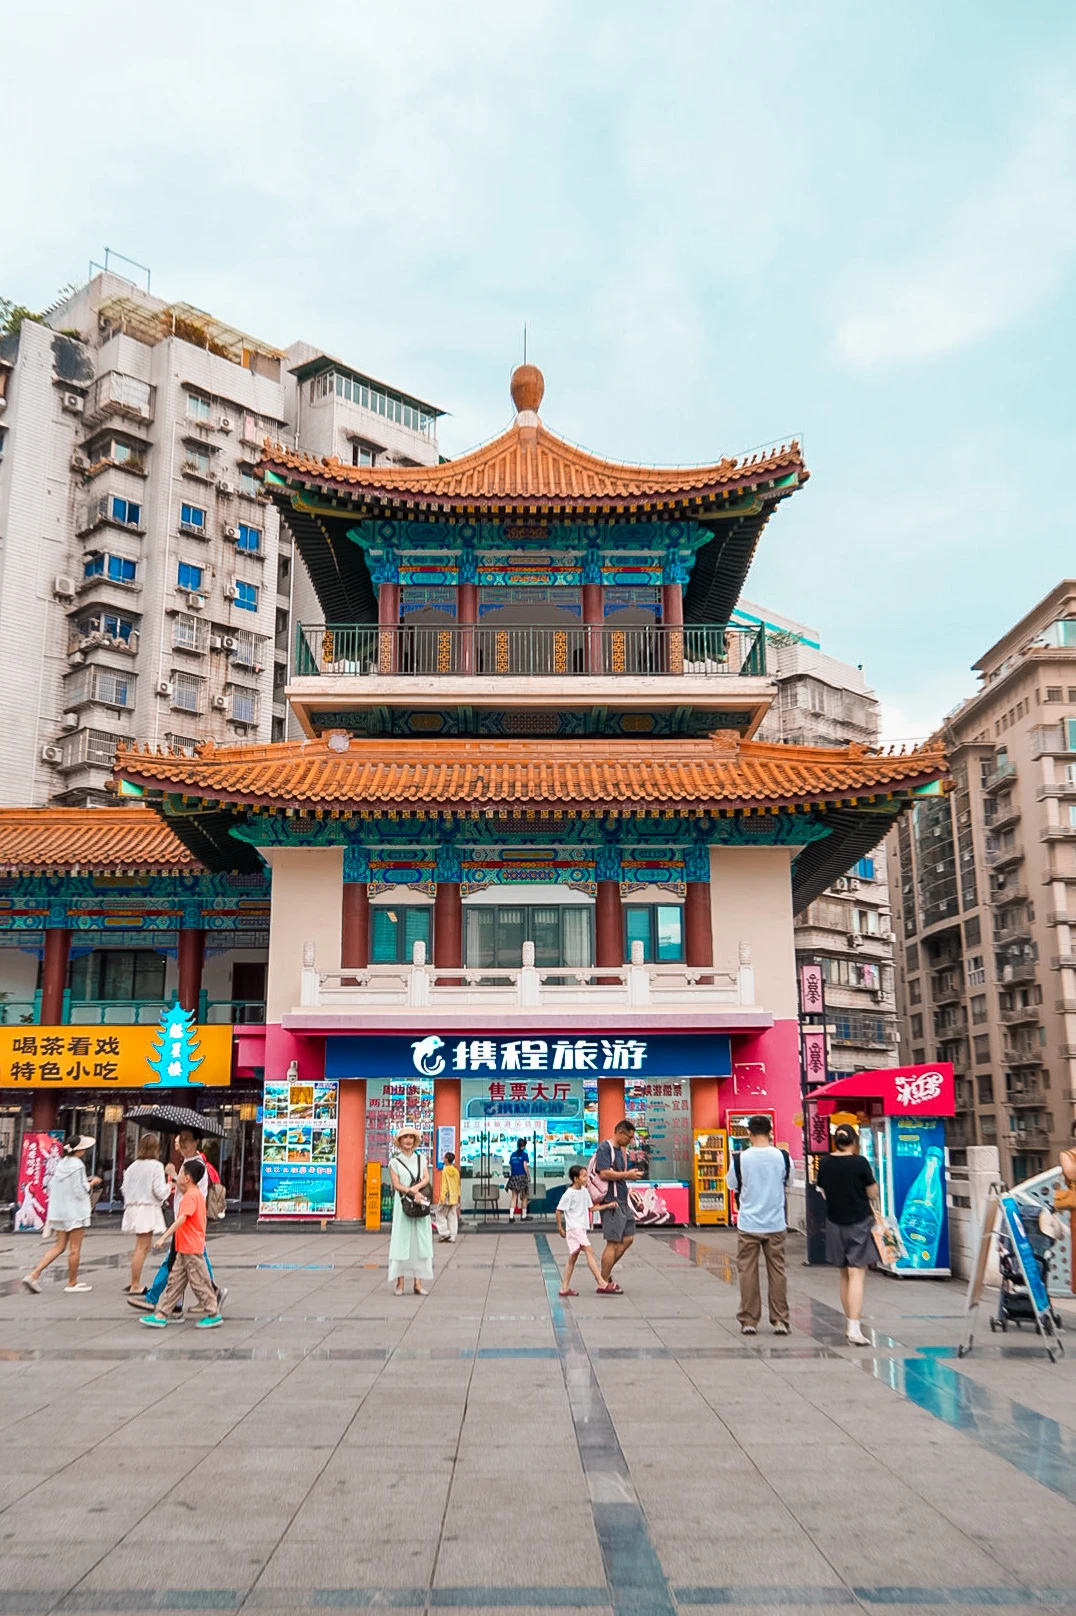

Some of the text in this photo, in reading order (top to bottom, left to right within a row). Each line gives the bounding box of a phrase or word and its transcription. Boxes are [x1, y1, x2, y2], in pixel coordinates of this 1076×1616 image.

[12, 1036, 120, 1057] 喝茶看戏
[452, 1039, 648, 1071] 携程旅游
[10, 1061, 119, 1081] 特色小吃
[488, 1082, 571, 1101] 售票大厅
